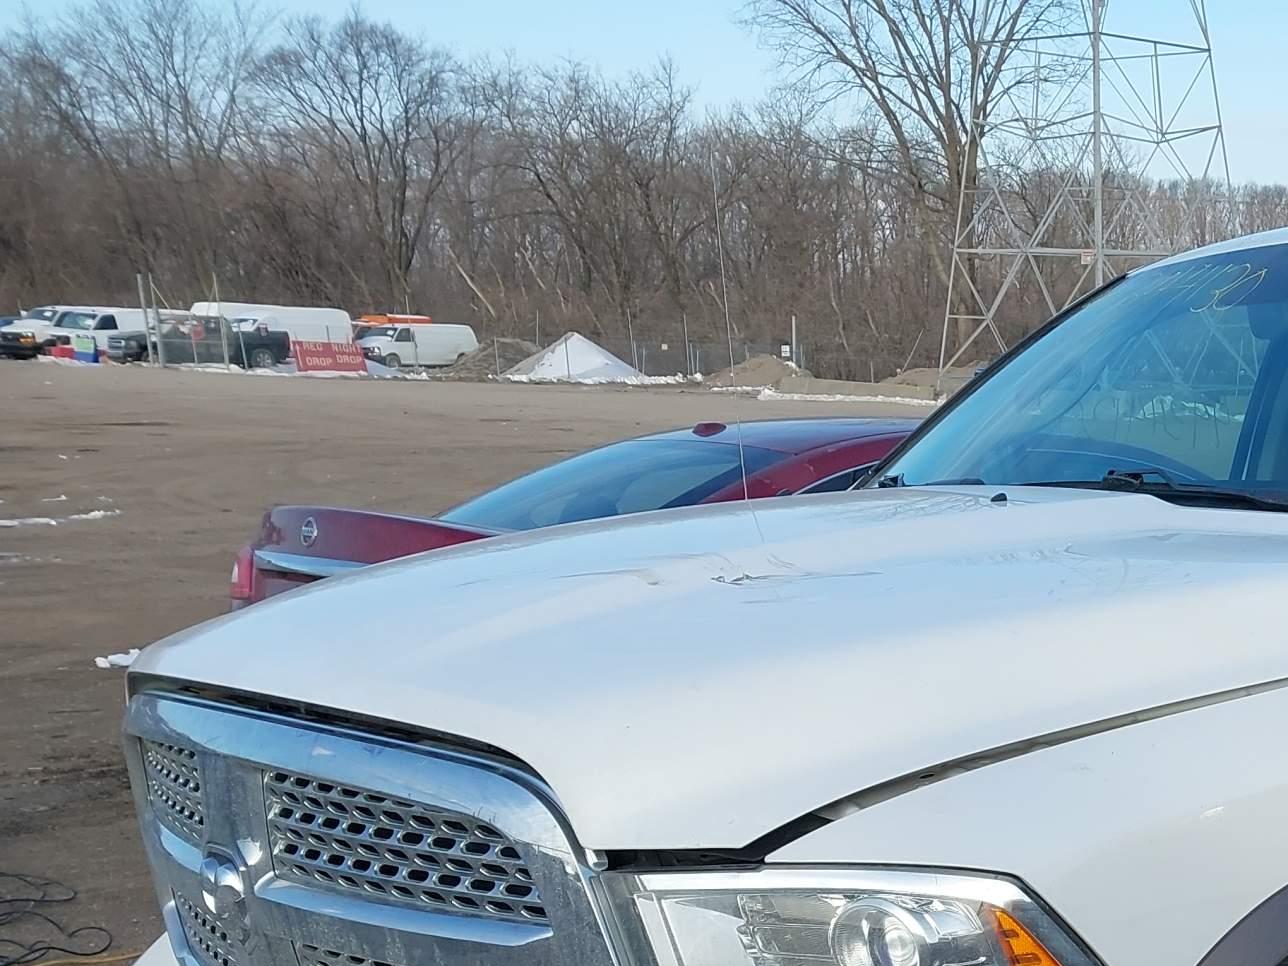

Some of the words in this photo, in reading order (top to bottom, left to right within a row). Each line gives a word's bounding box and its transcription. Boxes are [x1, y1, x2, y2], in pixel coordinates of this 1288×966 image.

[331, 343, 361, 353] NIGHT
[306, 357, 332, 366] DROP
[336, 354, 362, 364] DROP
